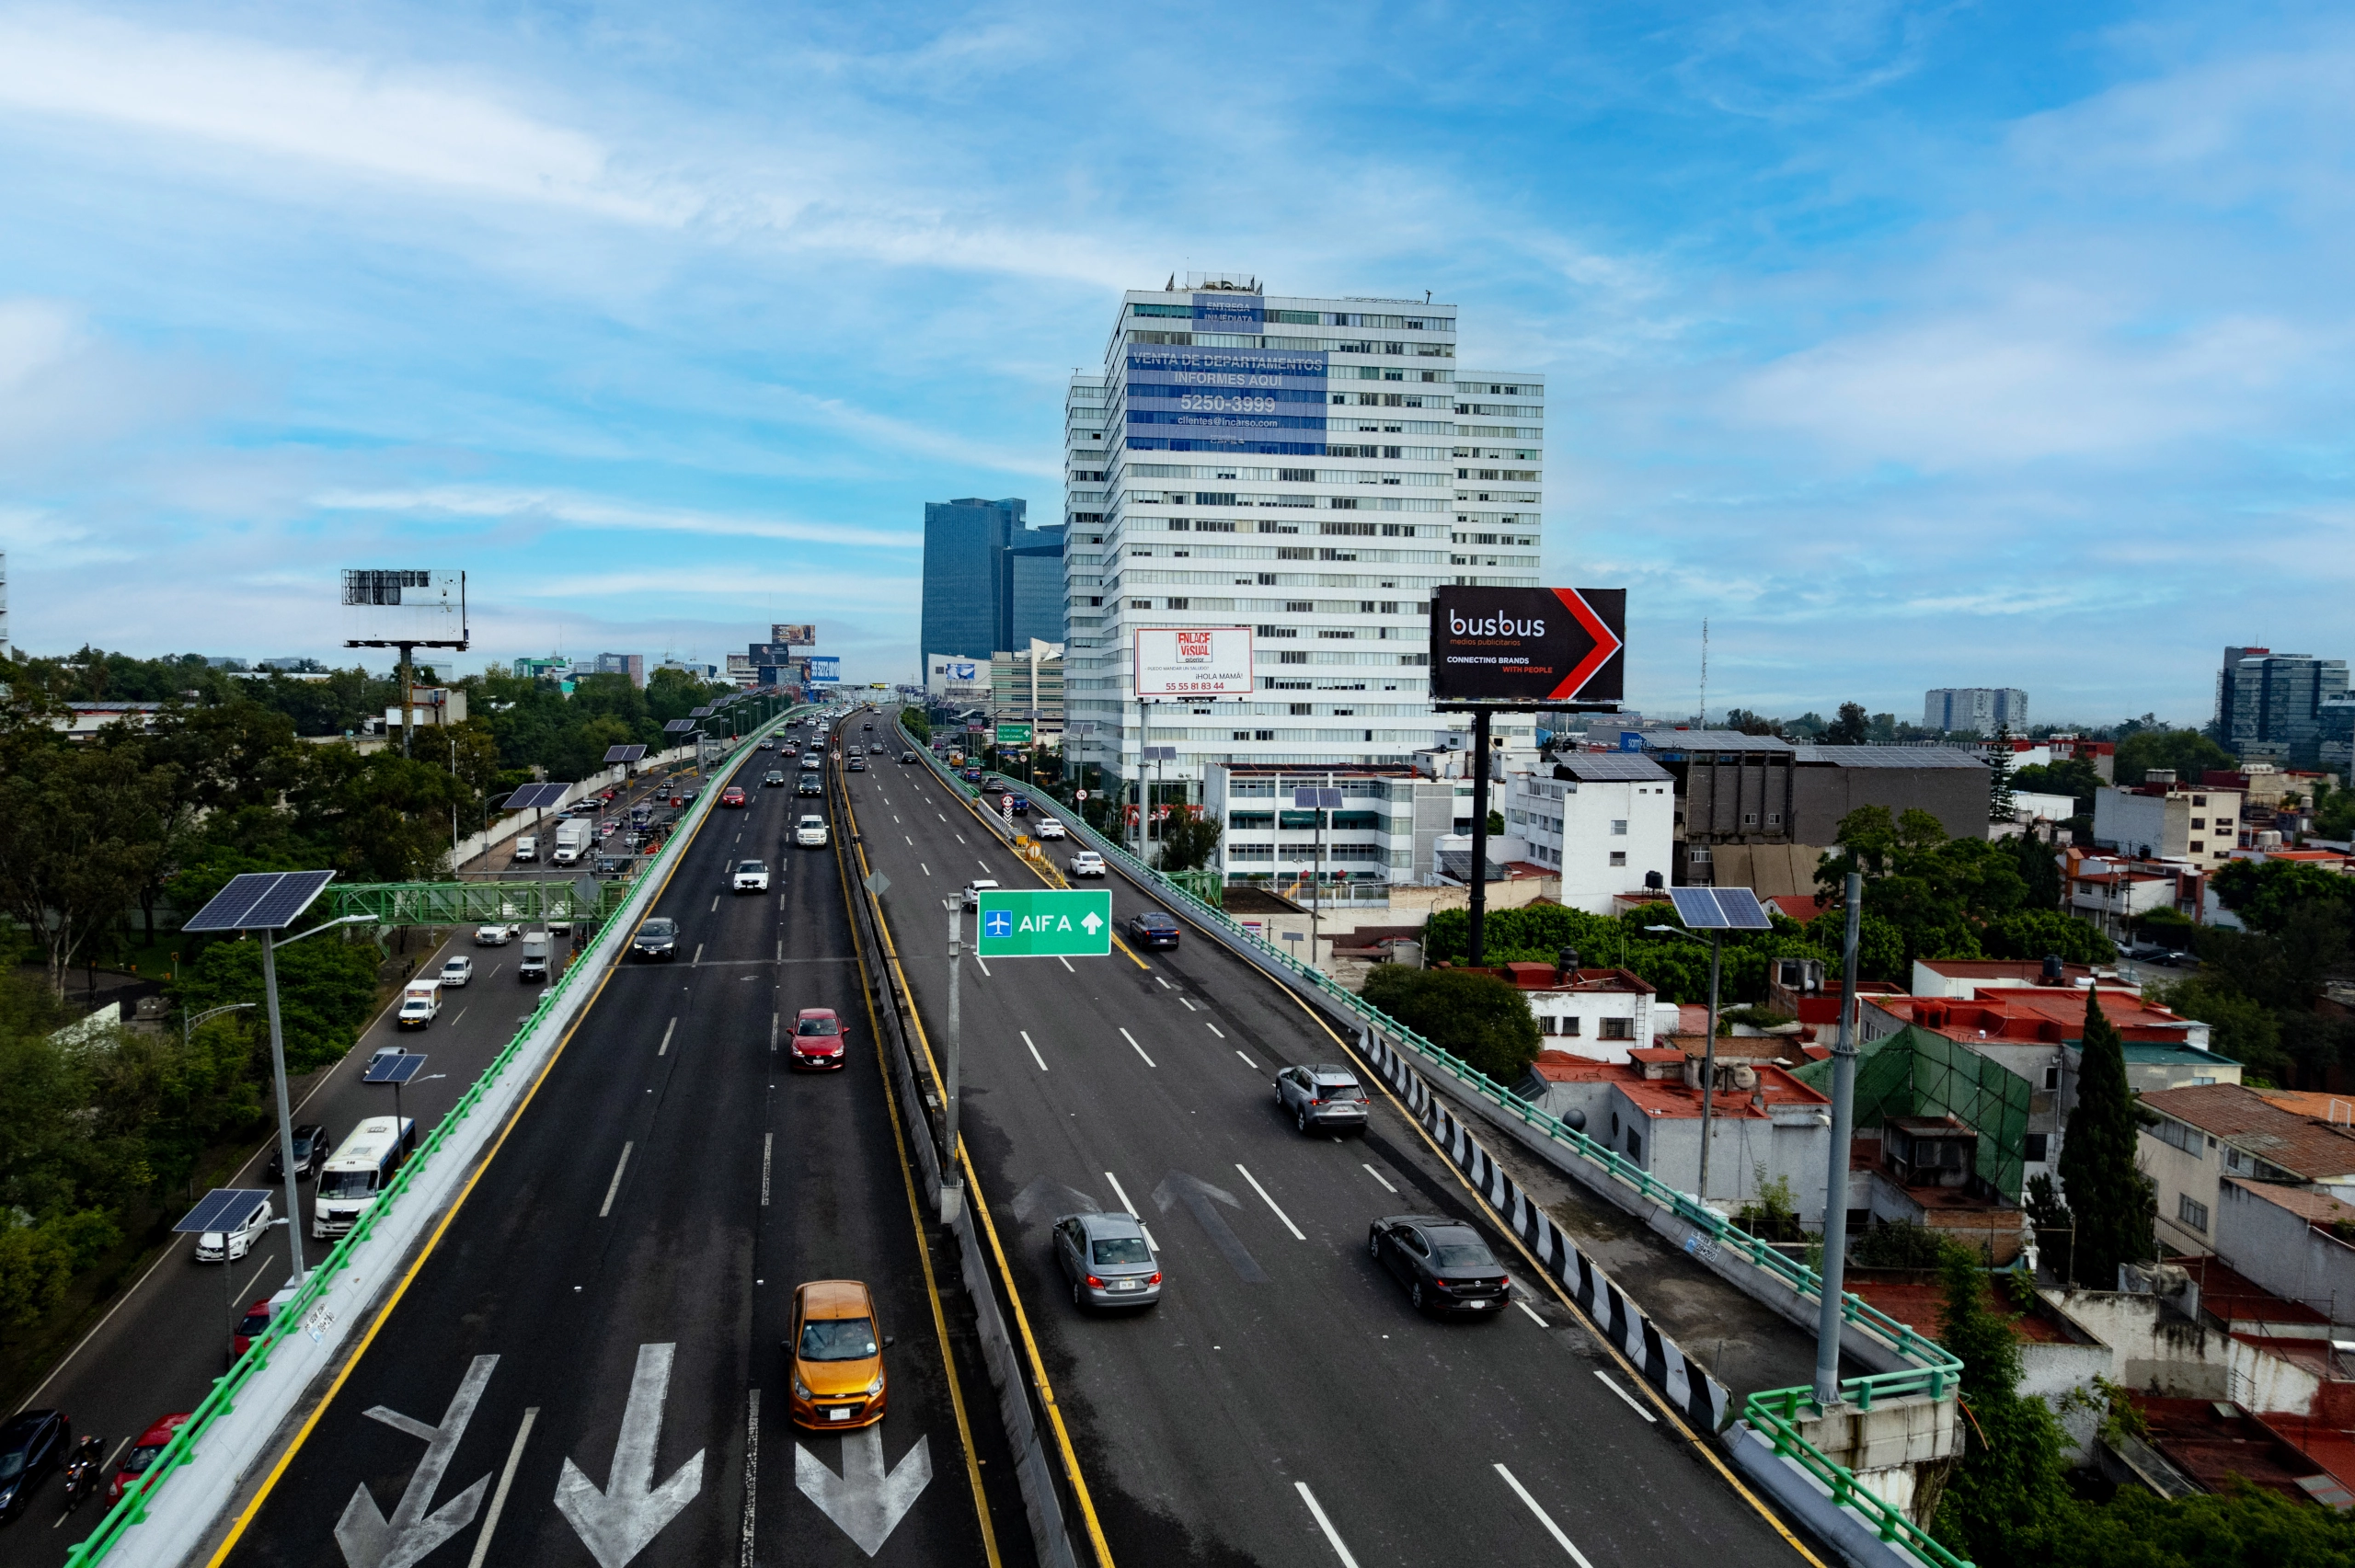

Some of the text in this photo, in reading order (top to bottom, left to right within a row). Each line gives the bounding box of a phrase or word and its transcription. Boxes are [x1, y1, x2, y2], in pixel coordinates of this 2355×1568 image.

[1206, 302, 1250, 312] ENTREGA
[1204, 314, 1253, 323] INMEDIATA
[1132, 351, 1324, 372] VENTA DE DEPARTAMENTOS
[1174, 372, 1283, 386] INFORMES AQUÍ
[1180, 394, 1276, 413] 5250-3999
[1177, 416, 1279, 429] clientes@incarso.com
[1450, 608, 1545, 637] busbus
[1178, 633, 1211, 644] ENLACE
[1477, 638, 1522, 647] publicitarios
[1446, 656, 1530, 665] CONNECTING BRANDS
[1523, 666, 1554, 674] PEOPLE
[1219, 671, 1243, 680] MAMÁ!
[1166, 682, 1176, 691] 55
[1178, 682, 1189, 691] 55
[1213, 681, 1224, 690] 44
[1018, 915, 1073, 933] AIFA
